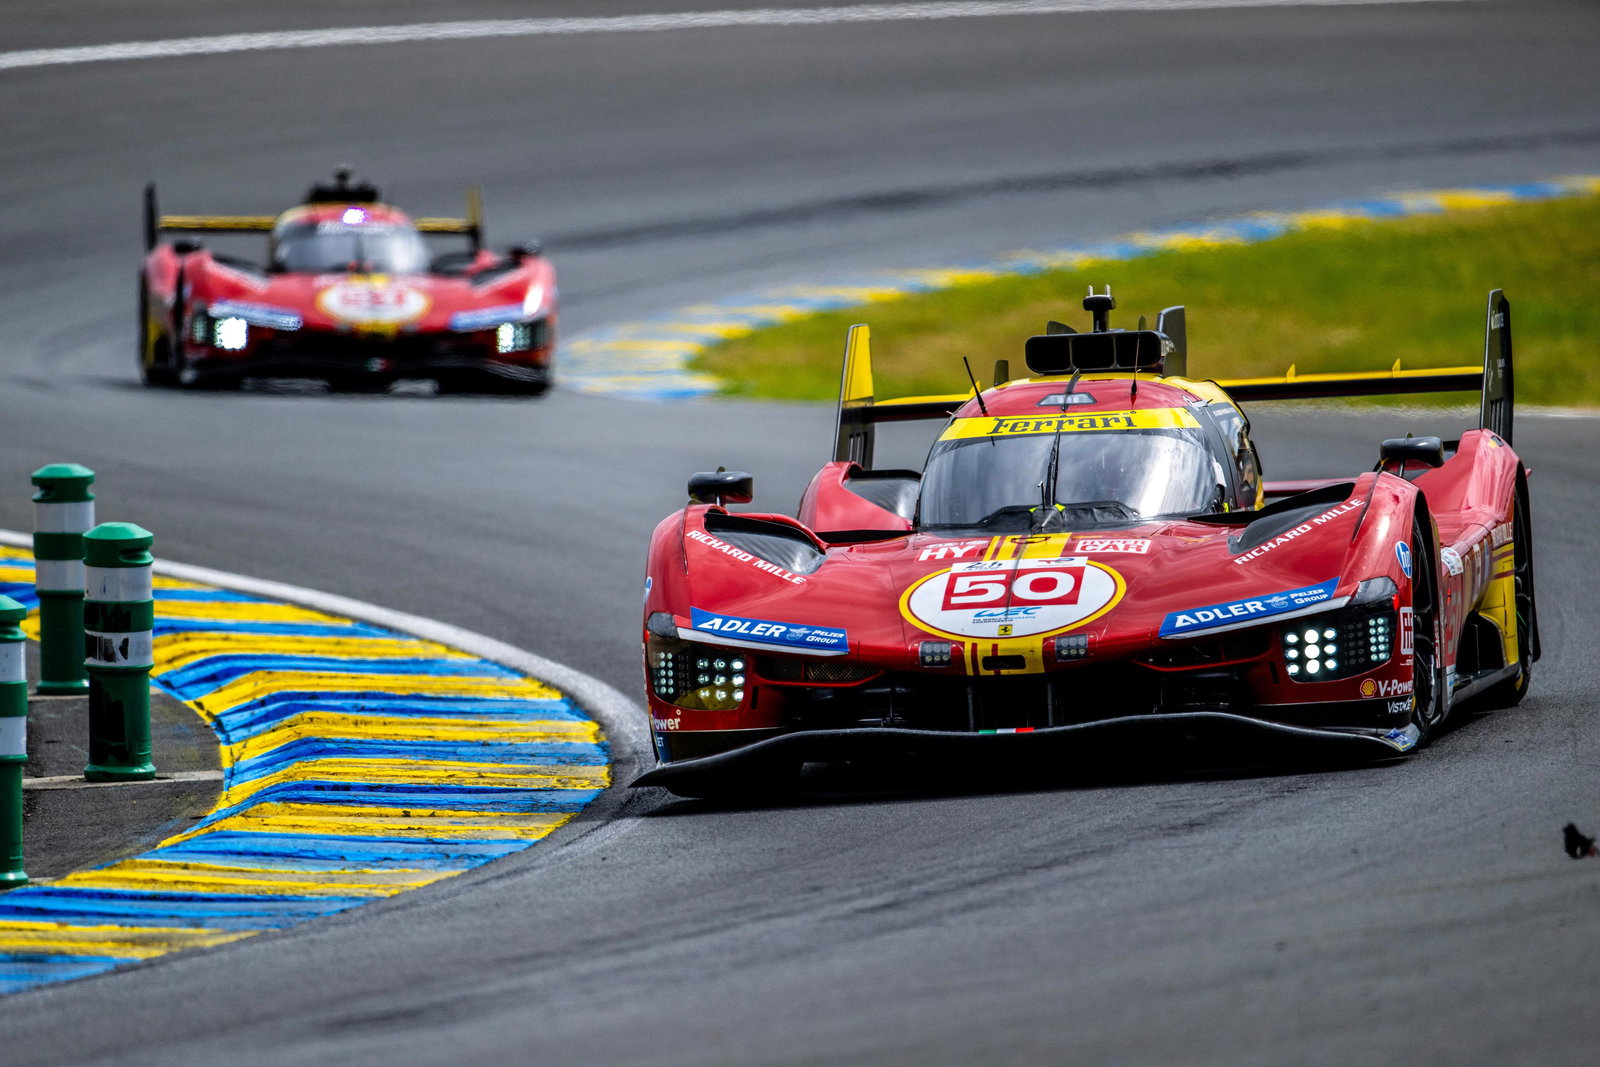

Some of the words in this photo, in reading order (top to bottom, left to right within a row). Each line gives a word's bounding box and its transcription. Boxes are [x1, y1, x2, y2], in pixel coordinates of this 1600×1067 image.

[987, 411, 1137, 435] Ferrari
[1234, 524, 1312, 565] RICHARD
[1313, 498, 1366, 525] MILLE
[686, 530, 750, 562] RICHARD
[752, 559, 807, 585] MILLE
[918, 545, 977, 561] HY
[1080, 544, 1144, 552] CAR
[950, 570, 1076, 605] 50
[1289, 588, 1325, 599] PELZER
[1293, 593, 1329, 605] GROUP
[1174, 600, 1267, 628] ADLER
[697, 616, 787, 638] ADLER
[811, 629, 845, 639] PELZER
[805, 635, 839, 644] GROUP
